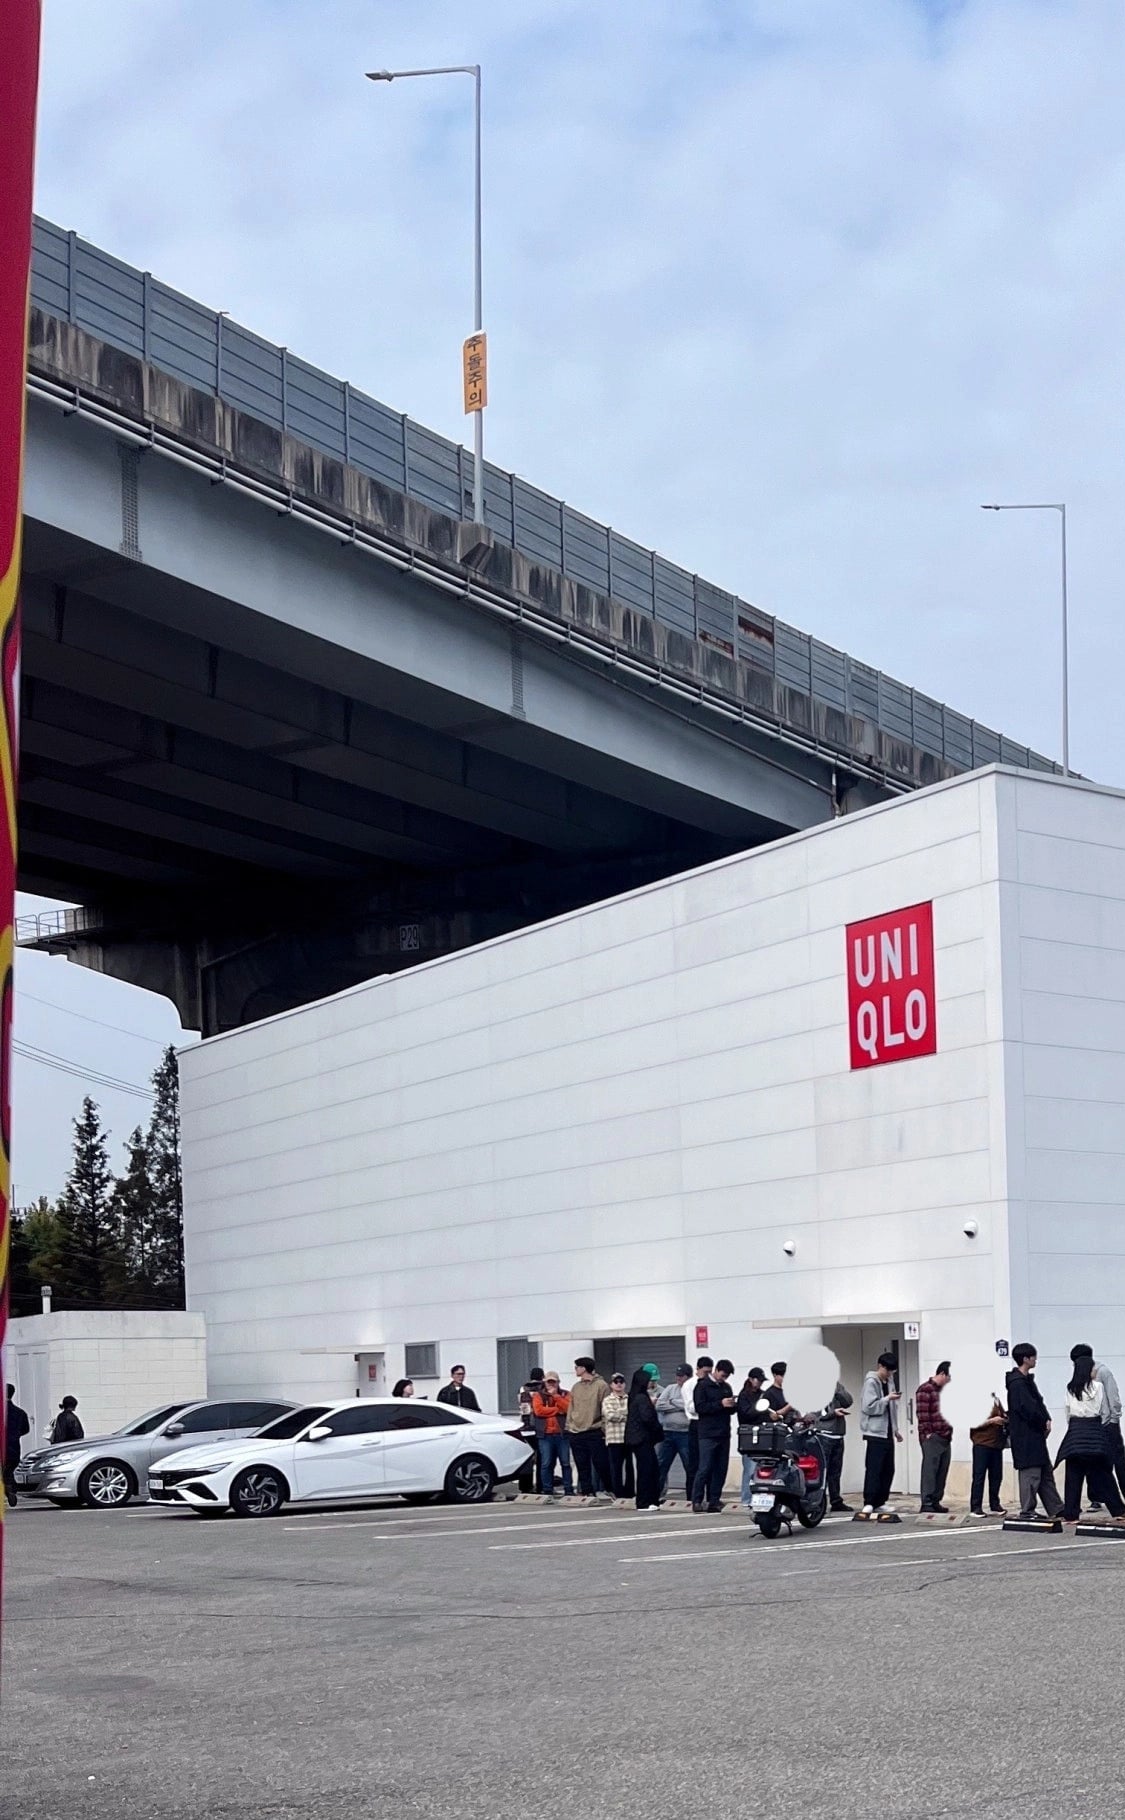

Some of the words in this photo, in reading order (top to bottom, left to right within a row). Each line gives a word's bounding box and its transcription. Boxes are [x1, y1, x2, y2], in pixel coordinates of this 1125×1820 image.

[467, 334, 483, 407] 추돌주의
[854, 923, 919, 988] UNI
[856, 988, 928, 1060] QLO
